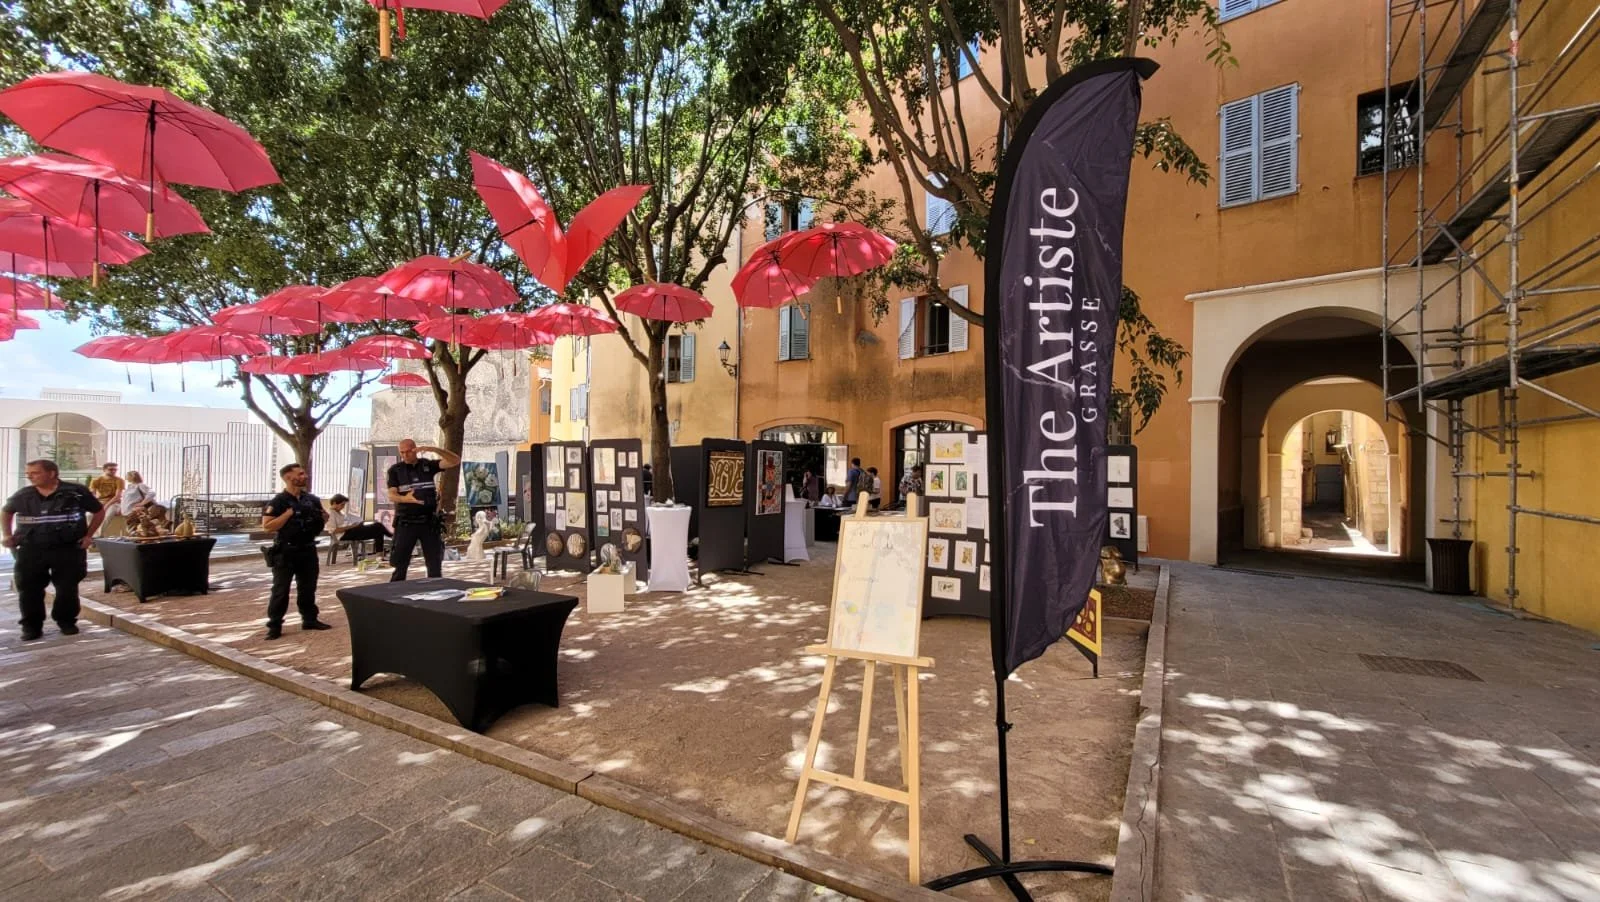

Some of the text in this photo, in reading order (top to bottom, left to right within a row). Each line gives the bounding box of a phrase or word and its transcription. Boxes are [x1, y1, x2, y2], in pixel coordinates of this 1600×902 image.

[1023, 187, 1079, 528] The Artiste
[1081, 297, 1100, 423] GRASSE
